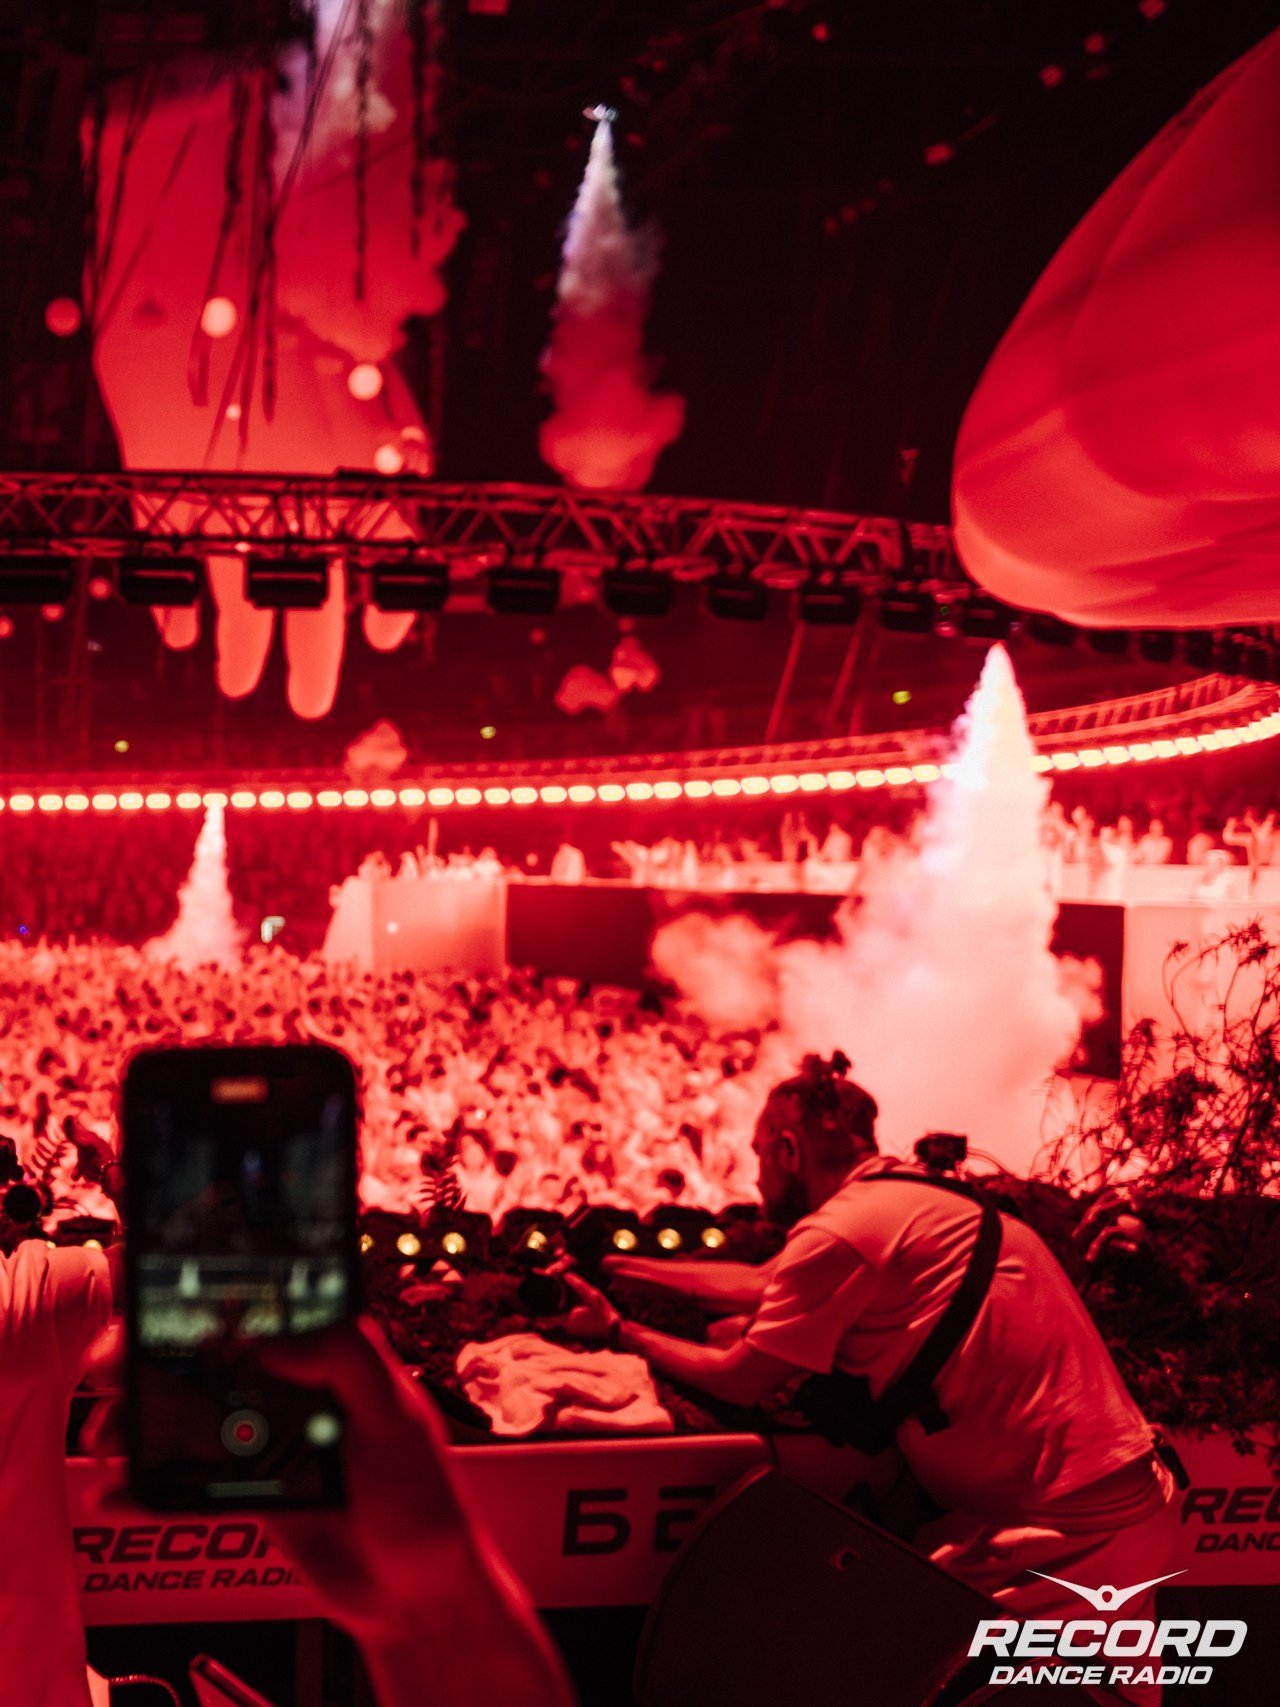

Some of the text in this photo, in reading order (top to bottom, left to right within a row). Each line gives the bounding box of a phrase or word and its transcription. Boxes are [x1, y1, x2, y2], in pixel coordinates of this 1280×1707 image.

[1181, 1486, 1280, 1526] RE
[72, 1523, 271, 1564] RECO
[82, 1569, 206, 1593] DANCE
